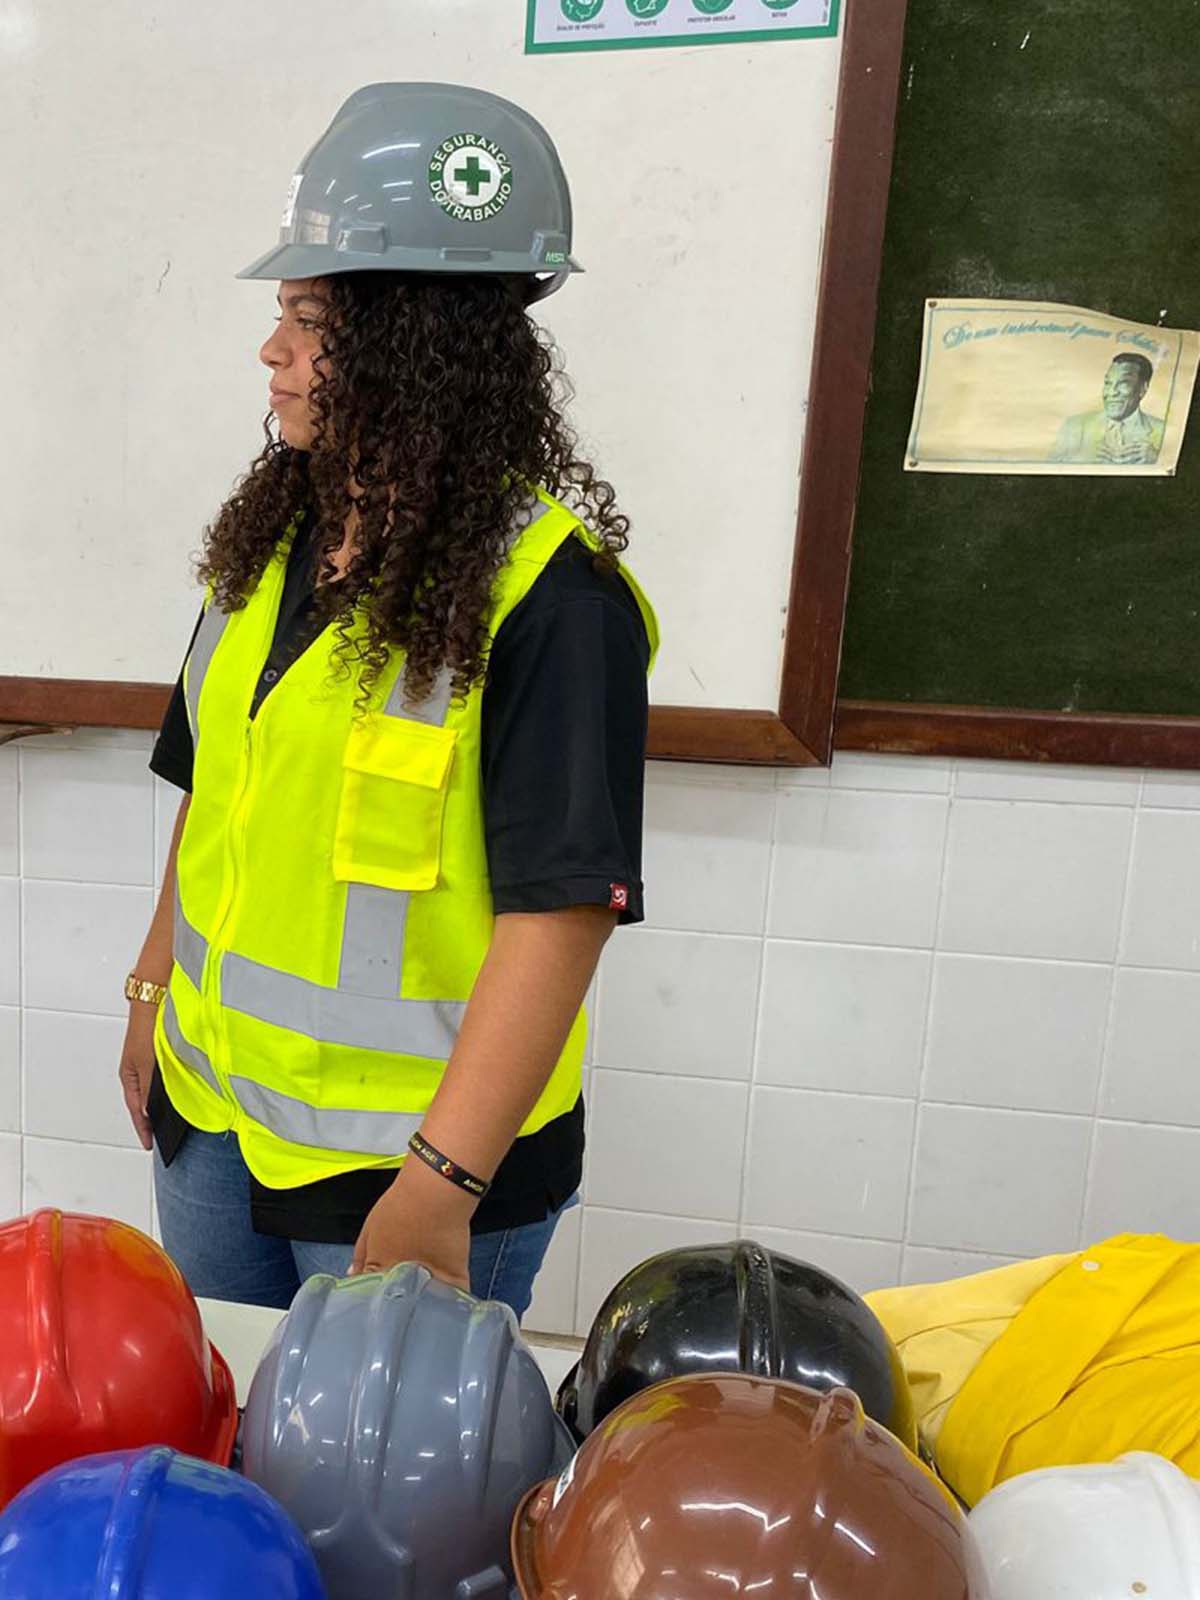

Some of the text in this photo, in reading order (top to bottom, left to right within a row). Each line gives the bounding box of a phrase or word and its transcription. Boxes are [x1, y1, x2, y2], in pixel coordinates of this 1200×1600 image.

[430, 133, 513, 178] SEGURANÇA
[430, 180, 513, 222] DO TRABALHO
